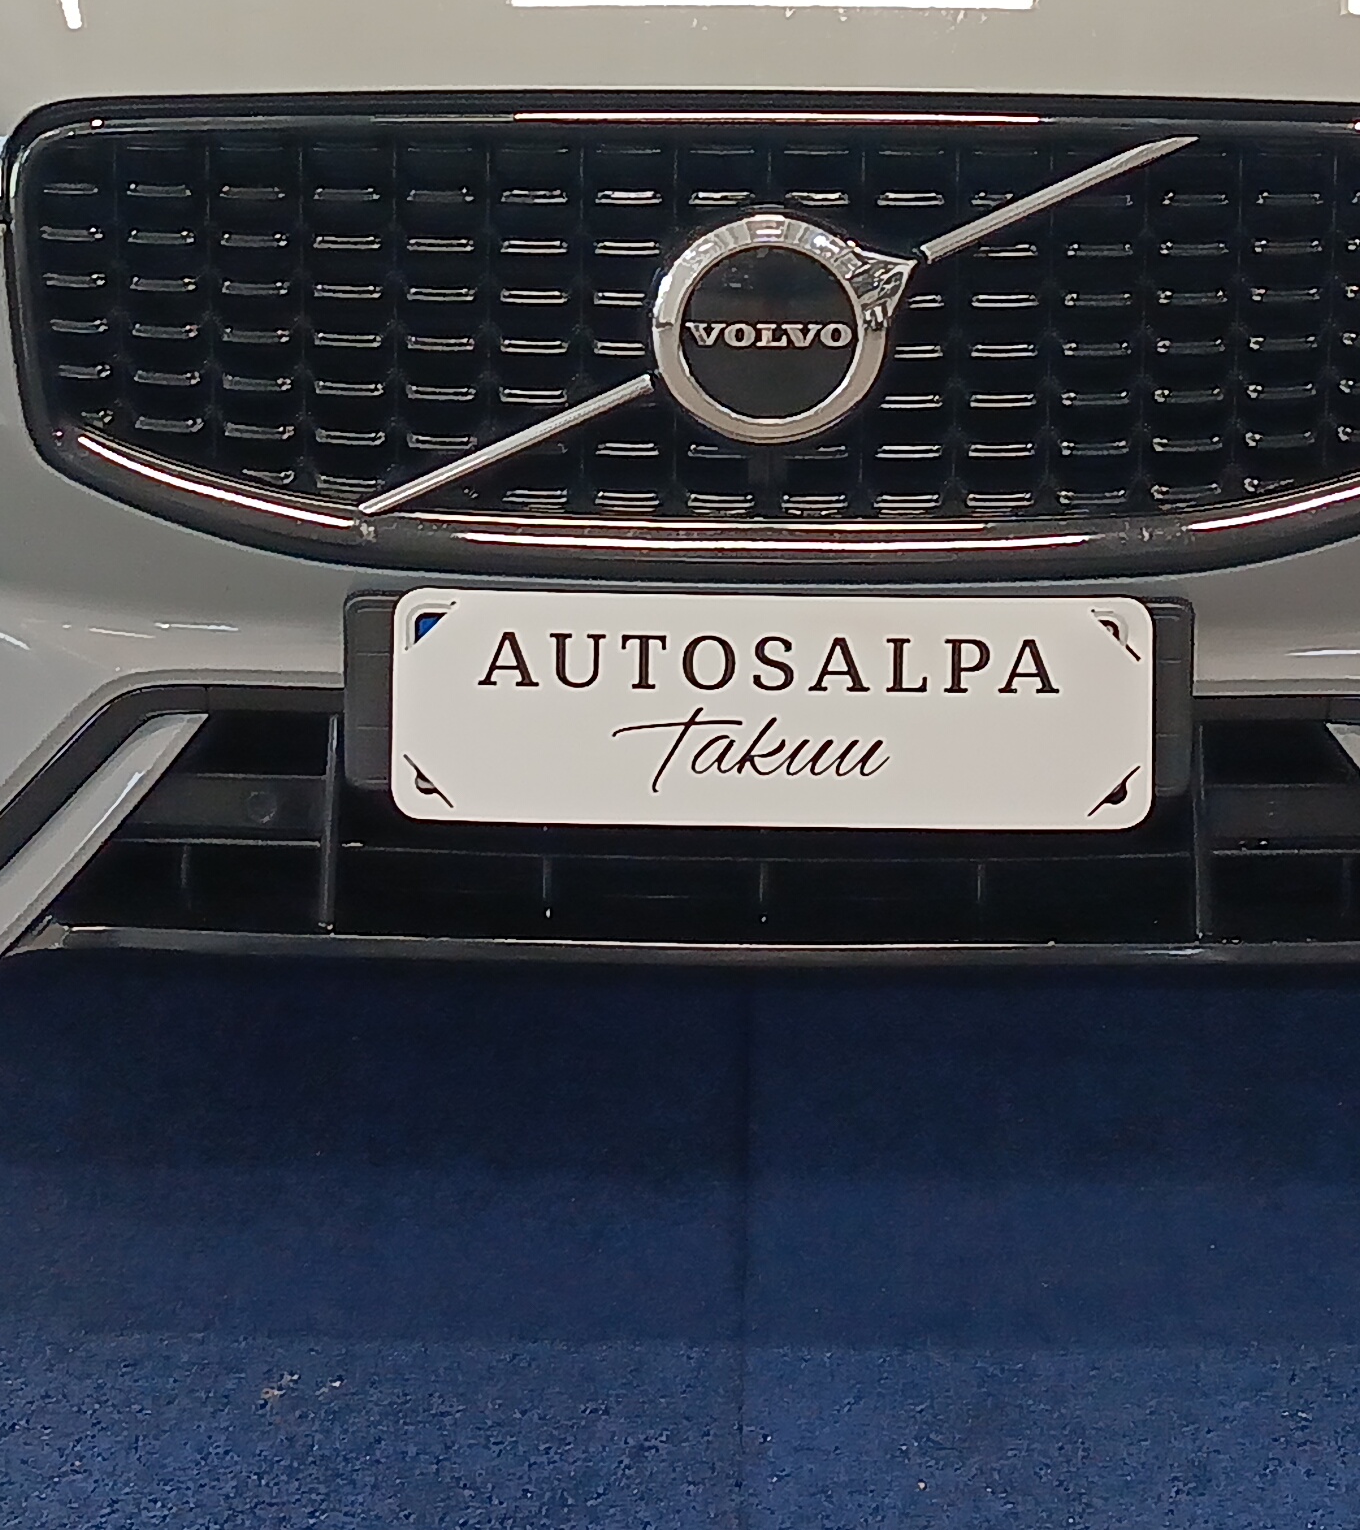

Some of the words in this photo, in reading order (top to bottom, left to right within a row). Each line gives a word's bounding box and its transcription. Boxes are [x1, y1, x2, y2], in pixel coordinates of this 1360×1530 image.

[685, 321, 853, 347] VOLVO
[478, 631, 1060, 695] AUTOSALPA
[612, 707, 890, 794] Takuu
